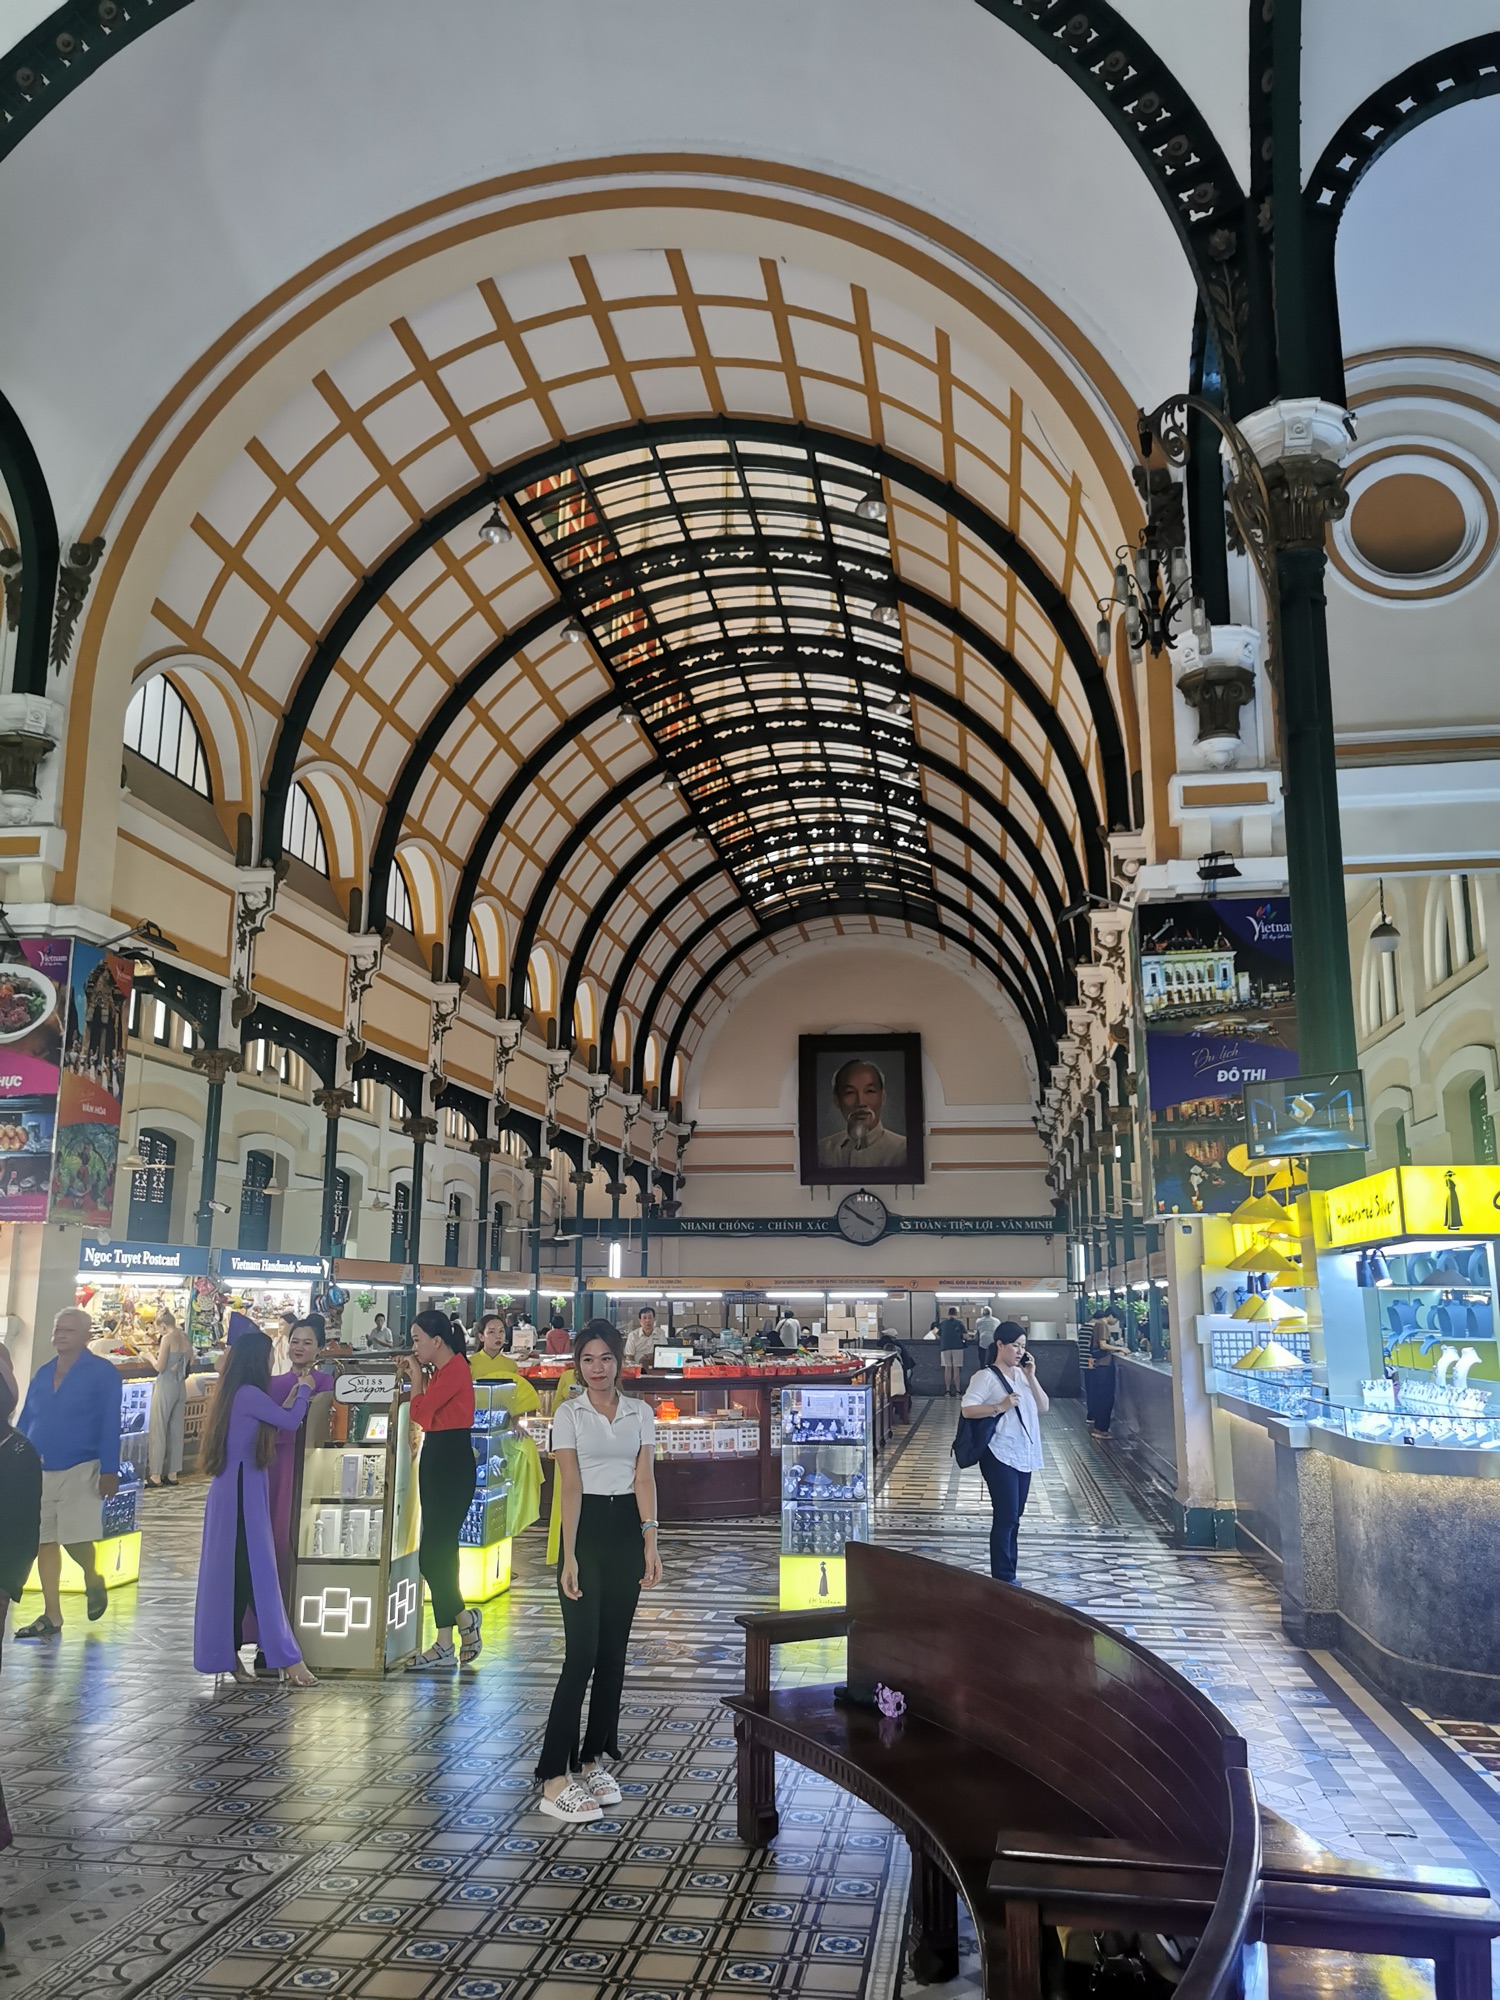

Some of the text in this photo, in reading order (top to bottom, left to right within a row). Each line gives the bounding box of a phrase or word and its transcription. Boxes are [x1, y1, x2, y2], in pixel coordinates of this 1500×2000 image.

[1245, 916, 1292, 942] Vietna
[1217, 1066, 1240, 1082] ĐÔ
[680, 1221, 715, 1230] NHANH
[718, 1219, 755, 1230] CHÓNG
[767, 1219, 803, 1230] CHÍNH
[806, 1219, 829, 1230] XÁC
[914, 1218, 942, 1230] TOÀN
[976, 1219, 993, 1231] LỢI
[1001, 1219, 1023, 1230] VĂN
[1025, 1221, 1053, 1230] MINH
[84, 1247, 180, 1268] Ngoc Tuyet Postcard
[231, 1257, 322, 1274] Vietnam Handmade Souvenir
[341, 1376, 395, 1401] Saigon
